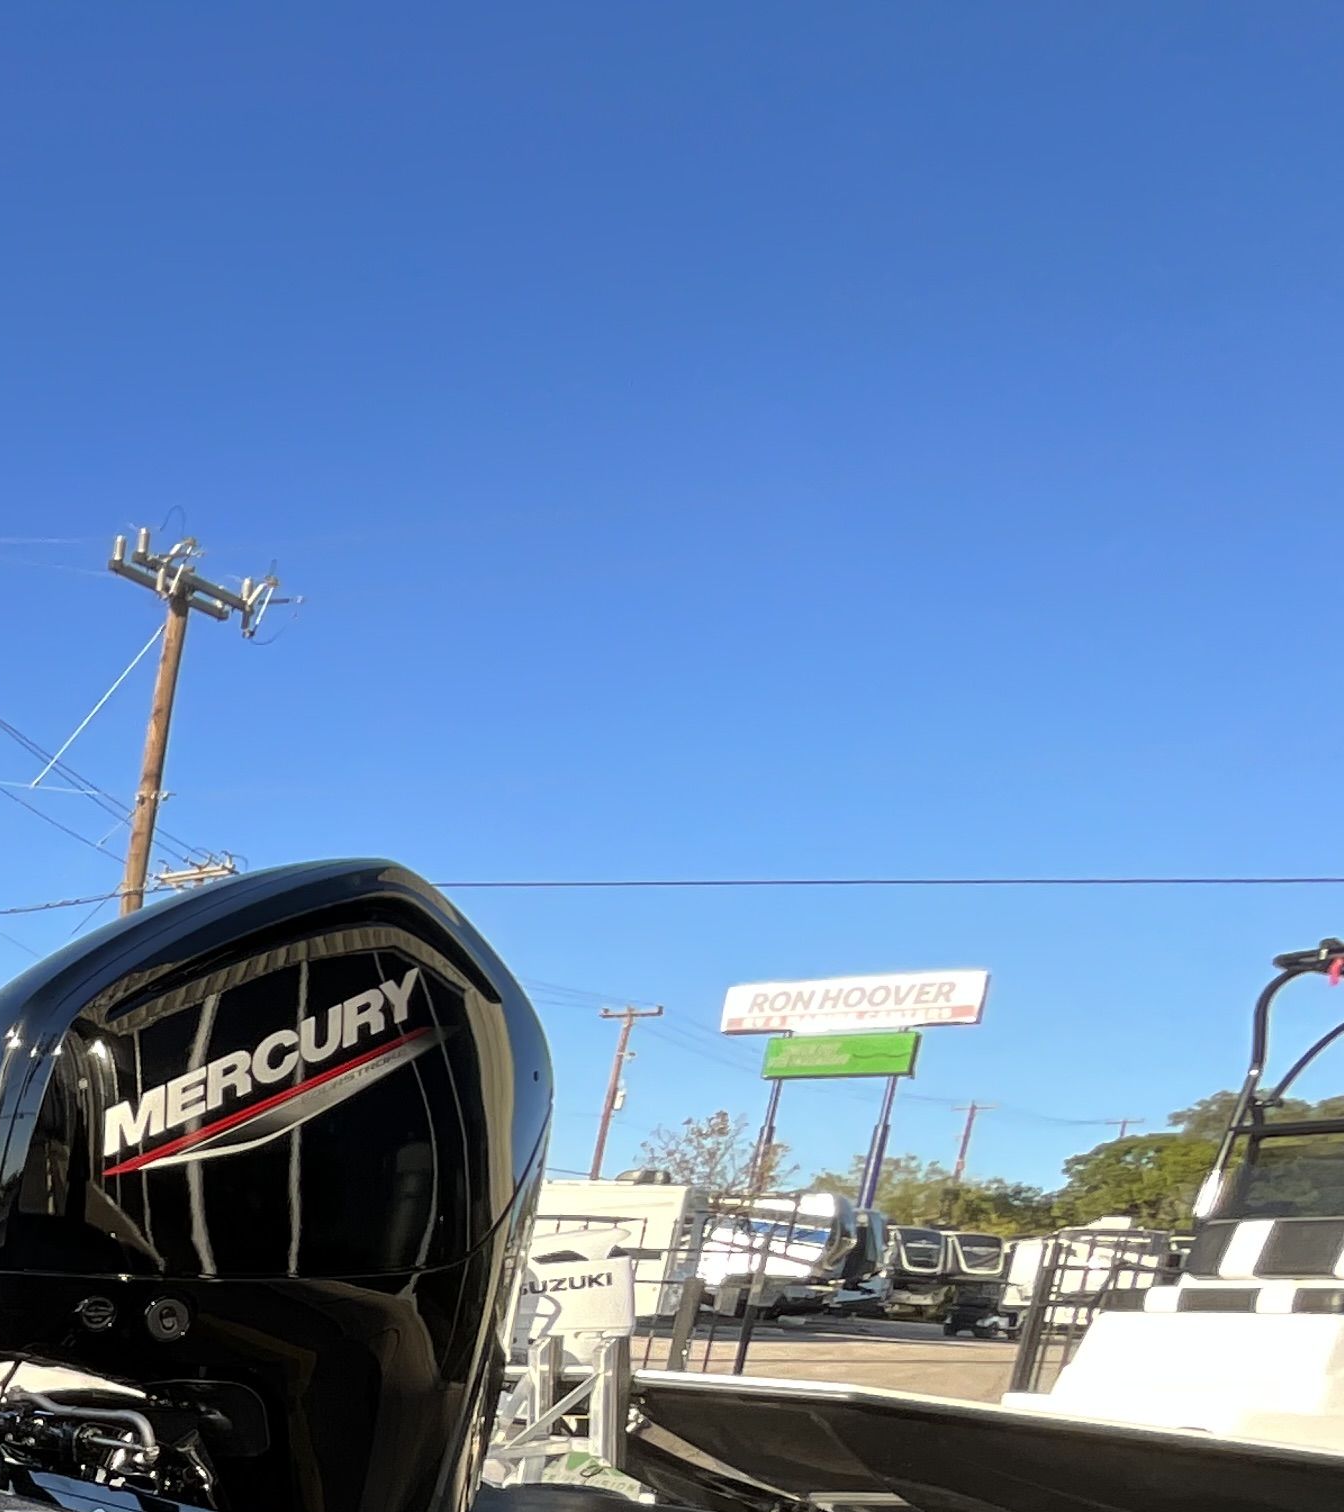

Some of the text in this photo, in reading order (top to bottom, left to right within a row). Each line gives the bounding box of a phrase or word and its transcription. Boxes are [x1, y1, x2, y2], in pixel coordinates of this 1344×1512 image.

[748, 981, 957, 1014] RON HOOVER
[103, 967, 420, 1157] MERCURY
